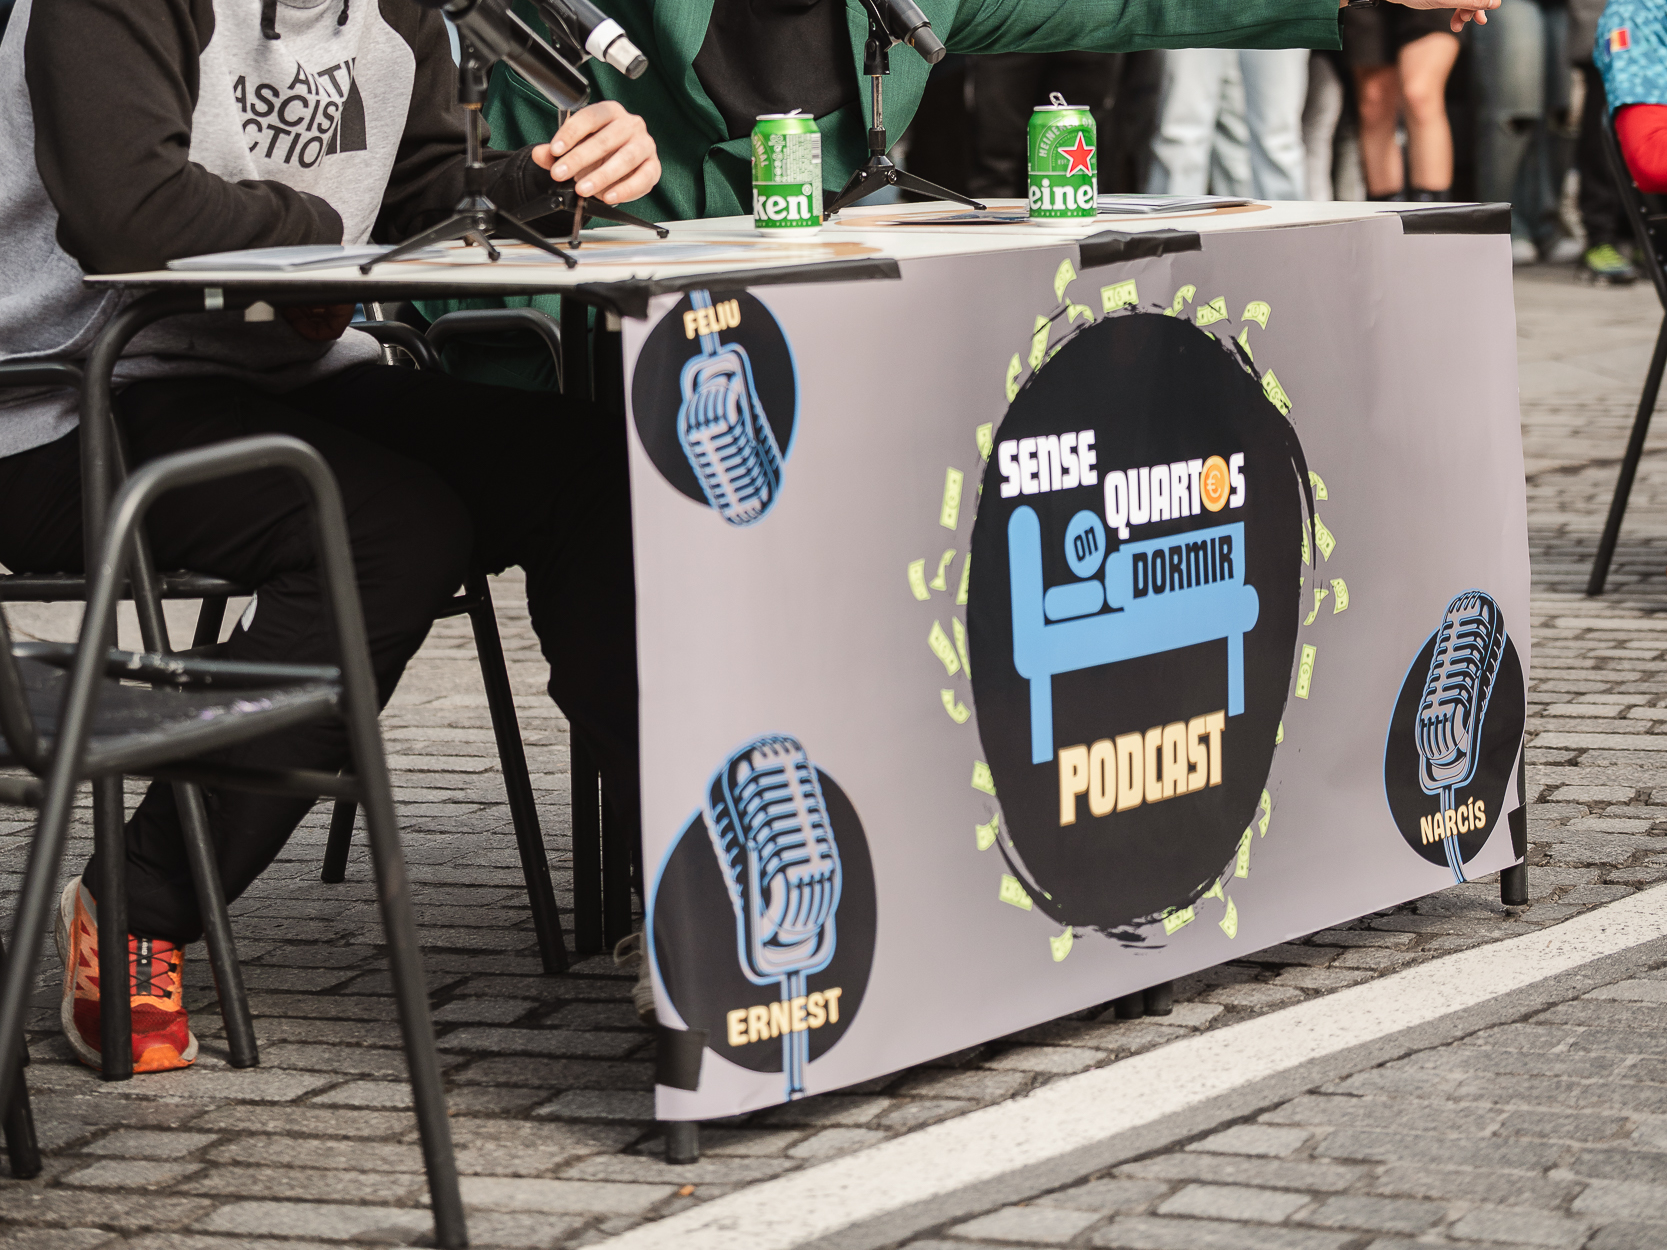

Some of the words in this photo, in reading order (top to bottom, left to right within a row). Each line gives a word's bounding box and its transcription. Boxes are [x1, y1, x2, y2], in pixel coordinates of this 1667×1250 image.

[242, 117, 331, 169] CTIO
[683, 298, 741, 340] FELIU
[998, 429, 1098, 498] SENSE
[1132, 534, 1235, 599] DORMIR
[1058, 709, 1226, 827] PODCAST
[727, 987, 843, 1047] ERNEST
